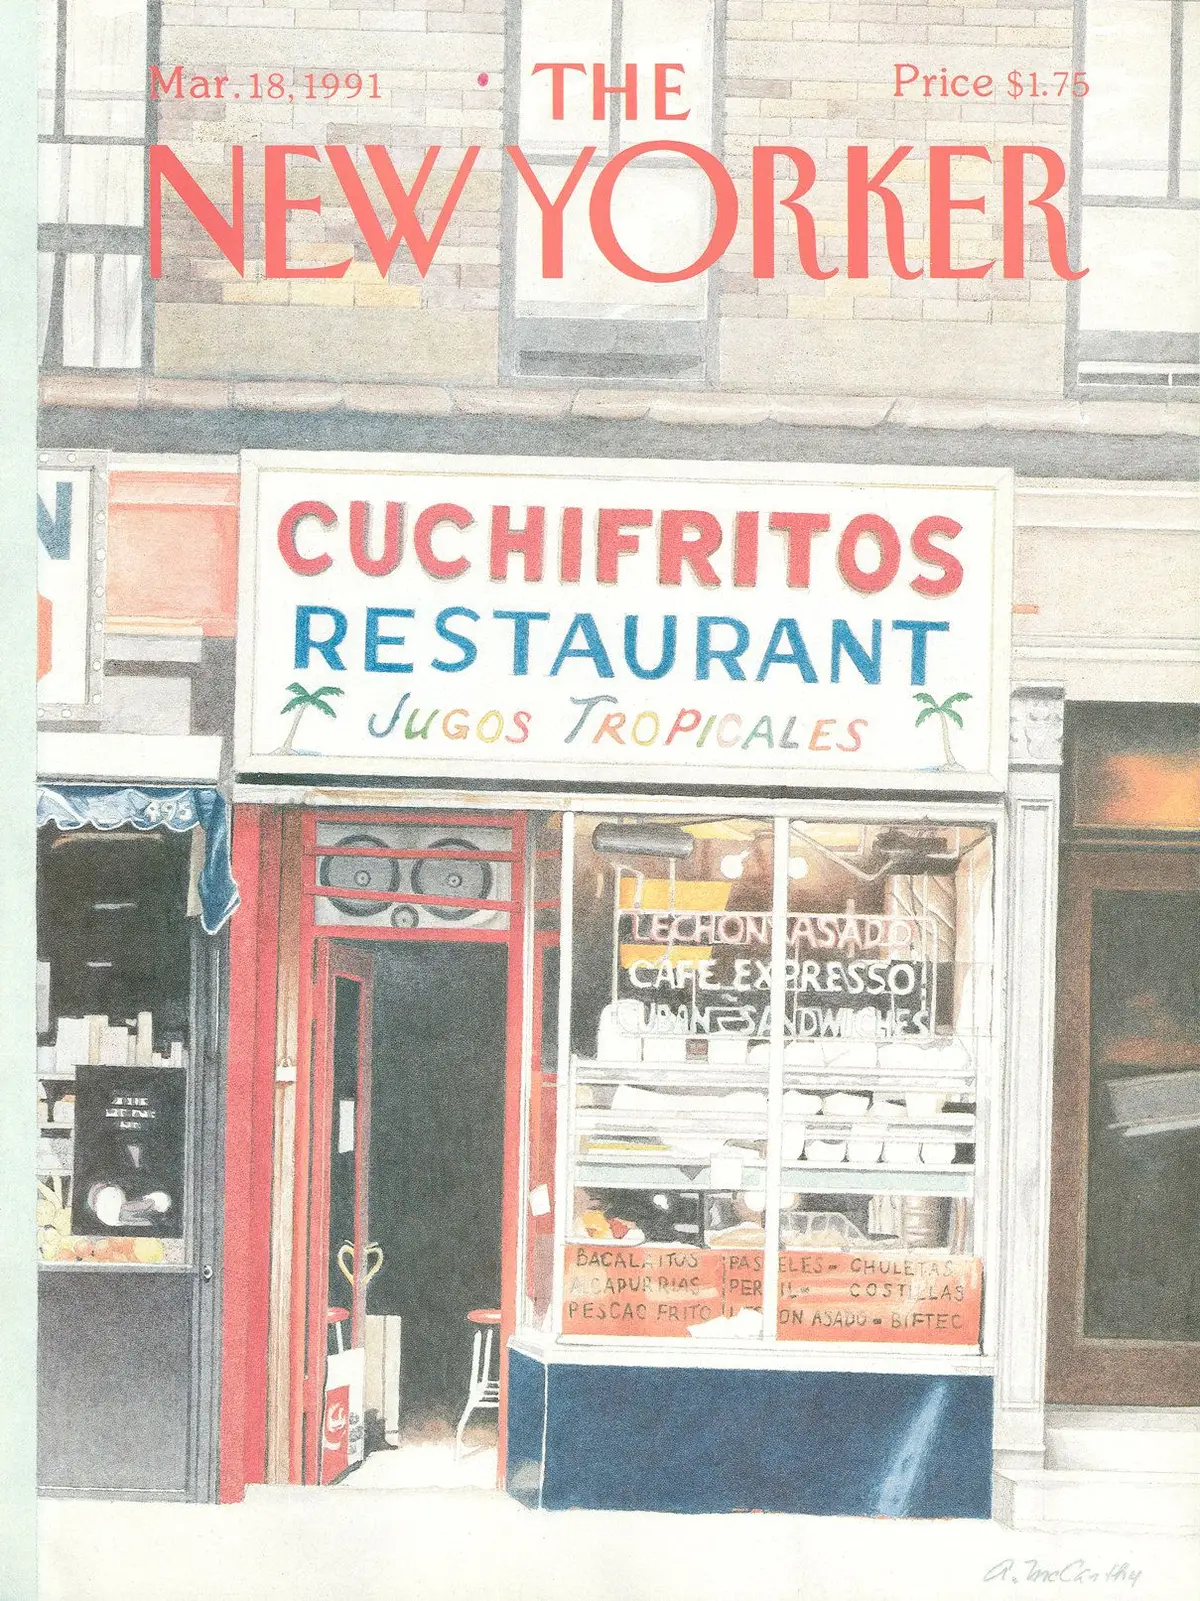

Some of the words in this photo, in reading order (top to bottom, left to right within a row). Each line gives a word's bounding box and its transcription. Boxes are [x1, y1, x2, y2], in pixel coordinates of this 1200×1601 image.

[531, 63, 691, 121] THE
[894, 64, 993, 98] Price
[1007, 71, 1091, 98] $1.75
[149, 145, 481, 279] NEW
[507, 140, 1090, 284] YORKER
[277, 500, 964, 598] CUCHIFRITOS
[294, 605, 950, 686] RESTAURANT
[368, 692, 532, 744] JUGOS
[563, 694, 869, 752] TROPICALES
[632, 912, 768, 944] LECHON
[788, 916, 912, 949] ASADO
[629, 959, 721, 990] CAFE
[733, 959, 916, 995] EXPRESSO
[850, 1258, 954, 1276] CHULETAS
[850, 1283, 965, 1302] COSTILLAS
